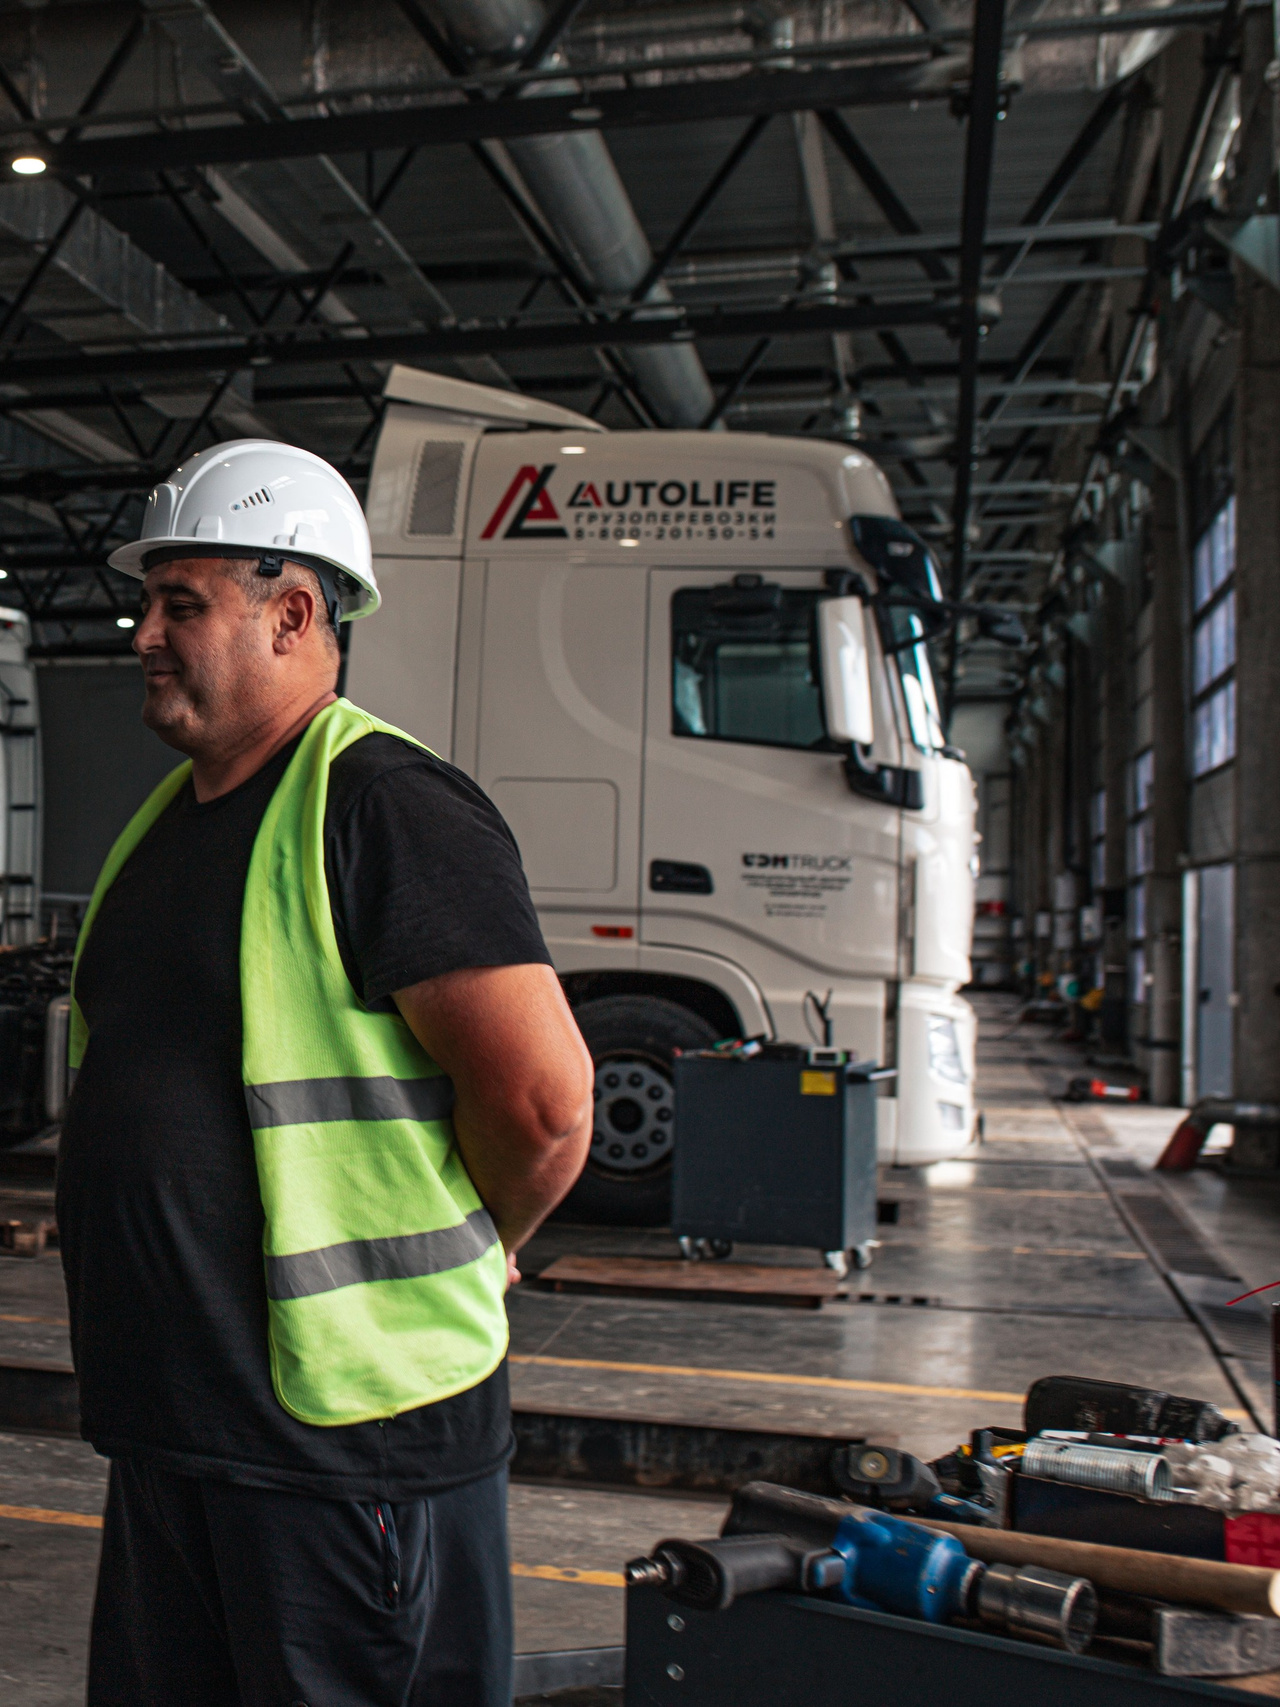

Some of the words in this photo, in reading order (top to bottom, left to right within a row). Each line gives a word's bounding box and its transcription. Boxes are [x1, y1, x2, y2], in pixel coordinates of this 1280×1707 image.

[567, 480, 776, 508] AUTOLIFE
[574, 511, 776, 526] ГРУЗОПЕРЕВОЗКИ
[574, 527, 776, 541] 8-800-201-50-54
